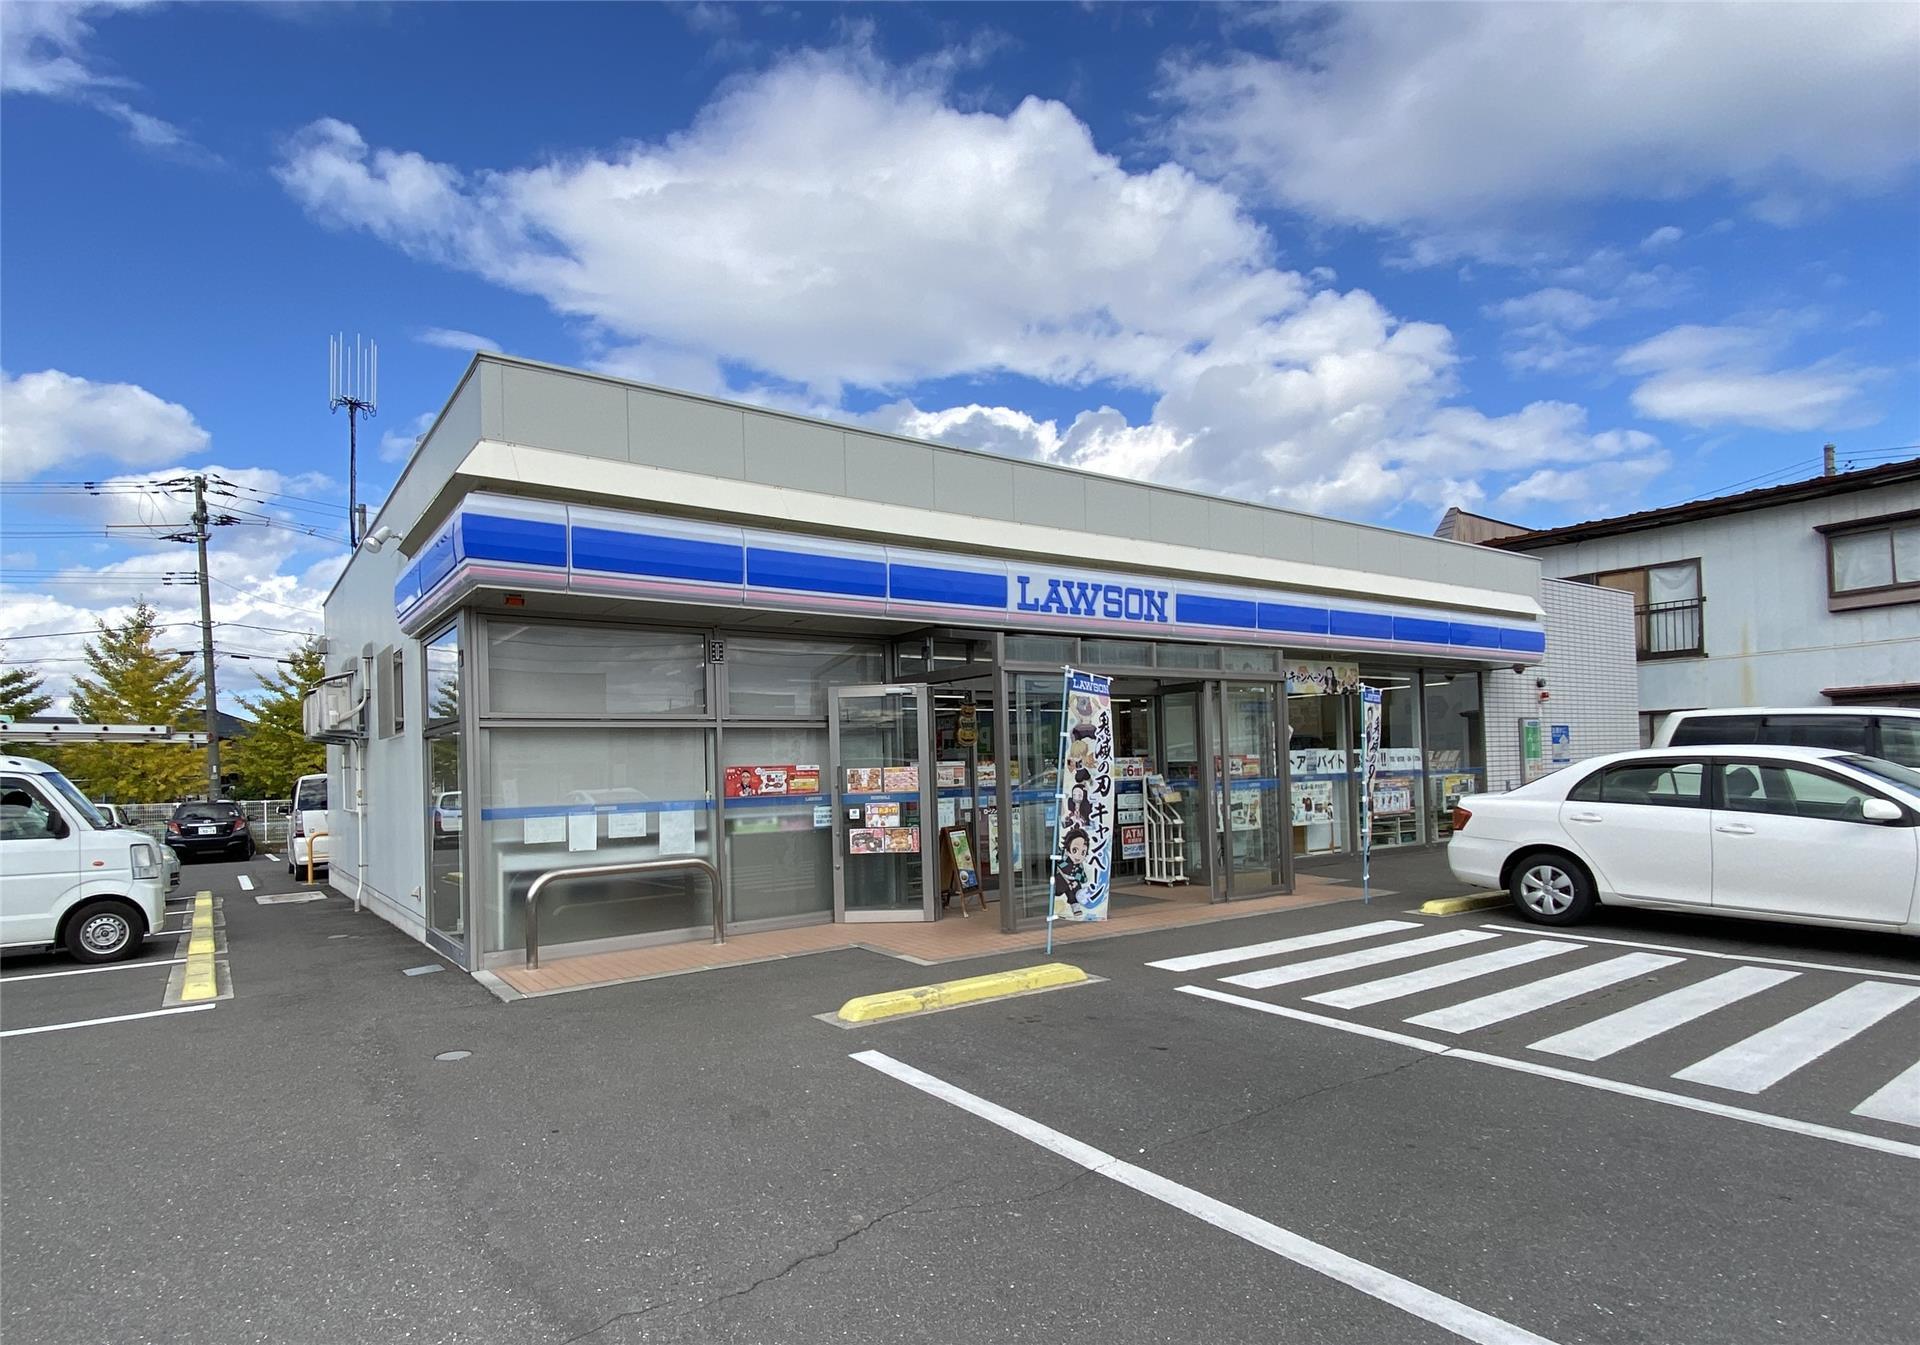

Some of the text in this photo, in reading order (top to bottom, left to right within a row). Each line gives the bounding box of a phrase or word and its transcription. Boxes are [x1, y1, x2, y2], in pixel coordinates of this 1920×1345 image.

[1017, 575, 1168, 623] LAWSON
[1072, 678, 1110, 694] LAWSON
[1125, 829, 1144, 839] ATM
